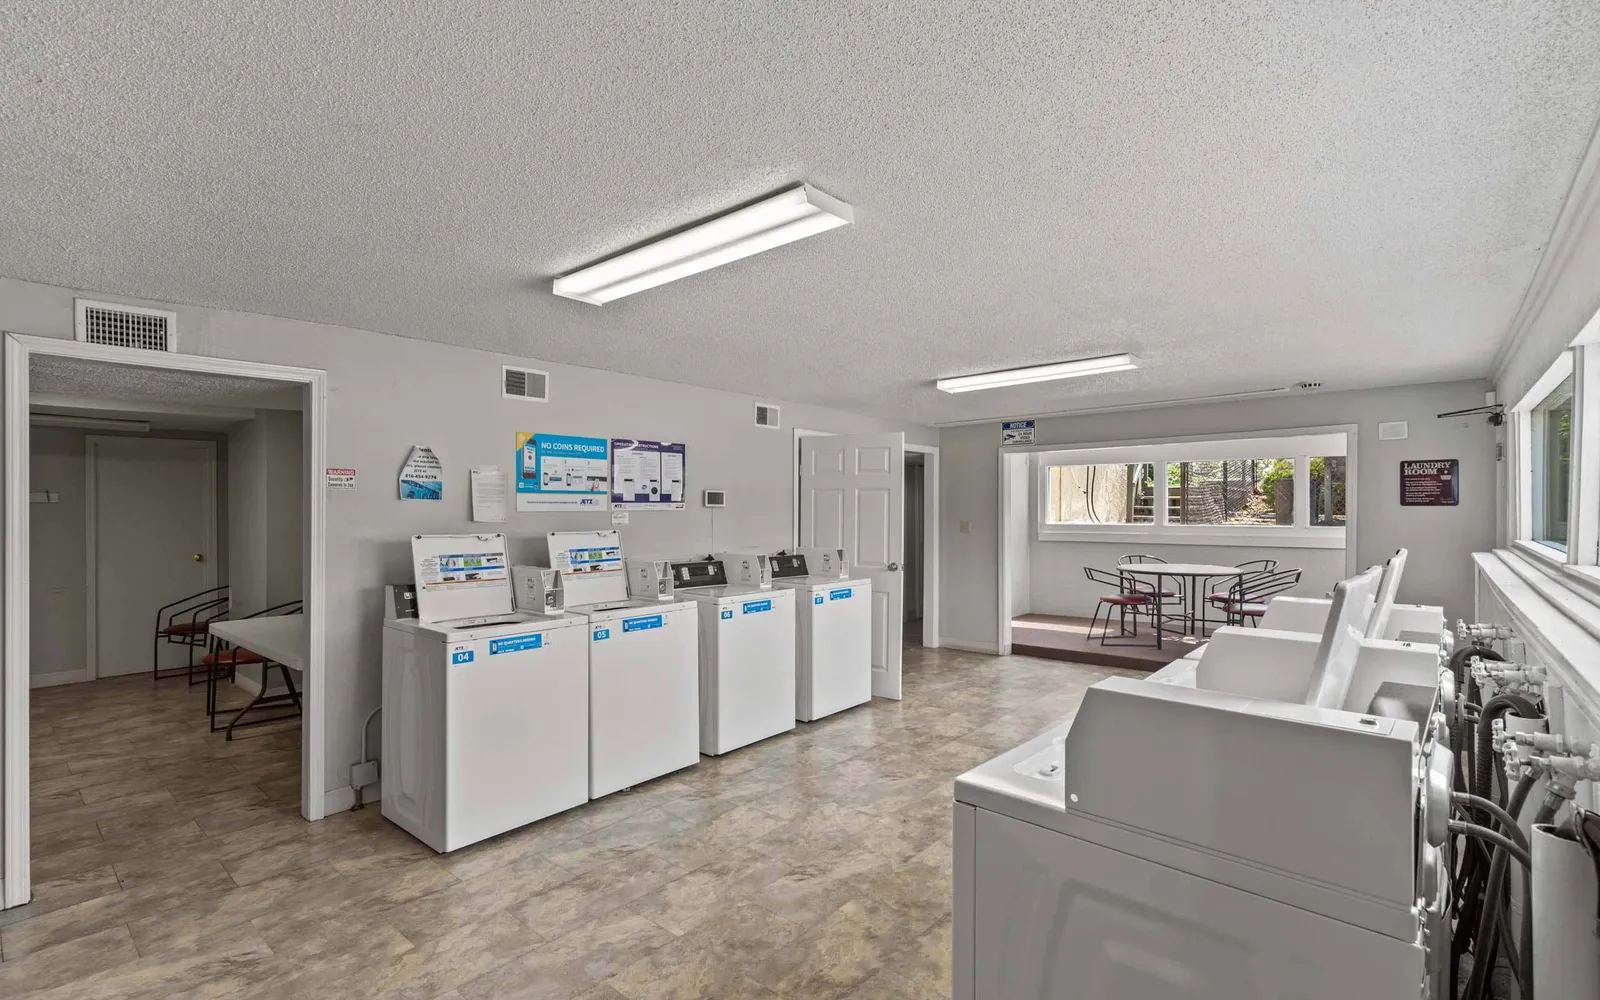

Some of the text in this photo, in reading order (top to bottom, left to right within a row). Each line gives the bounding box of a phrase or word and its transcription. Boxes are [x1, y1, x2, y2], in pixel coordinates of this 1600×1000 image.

[541, 442, 551, 450] NO
[553, 443, 573, 451] COINS
[574, 444, 605, 453] REQUIRED
[597, 631, 606, 639] 05
[457, 653, 469, 662] 04
